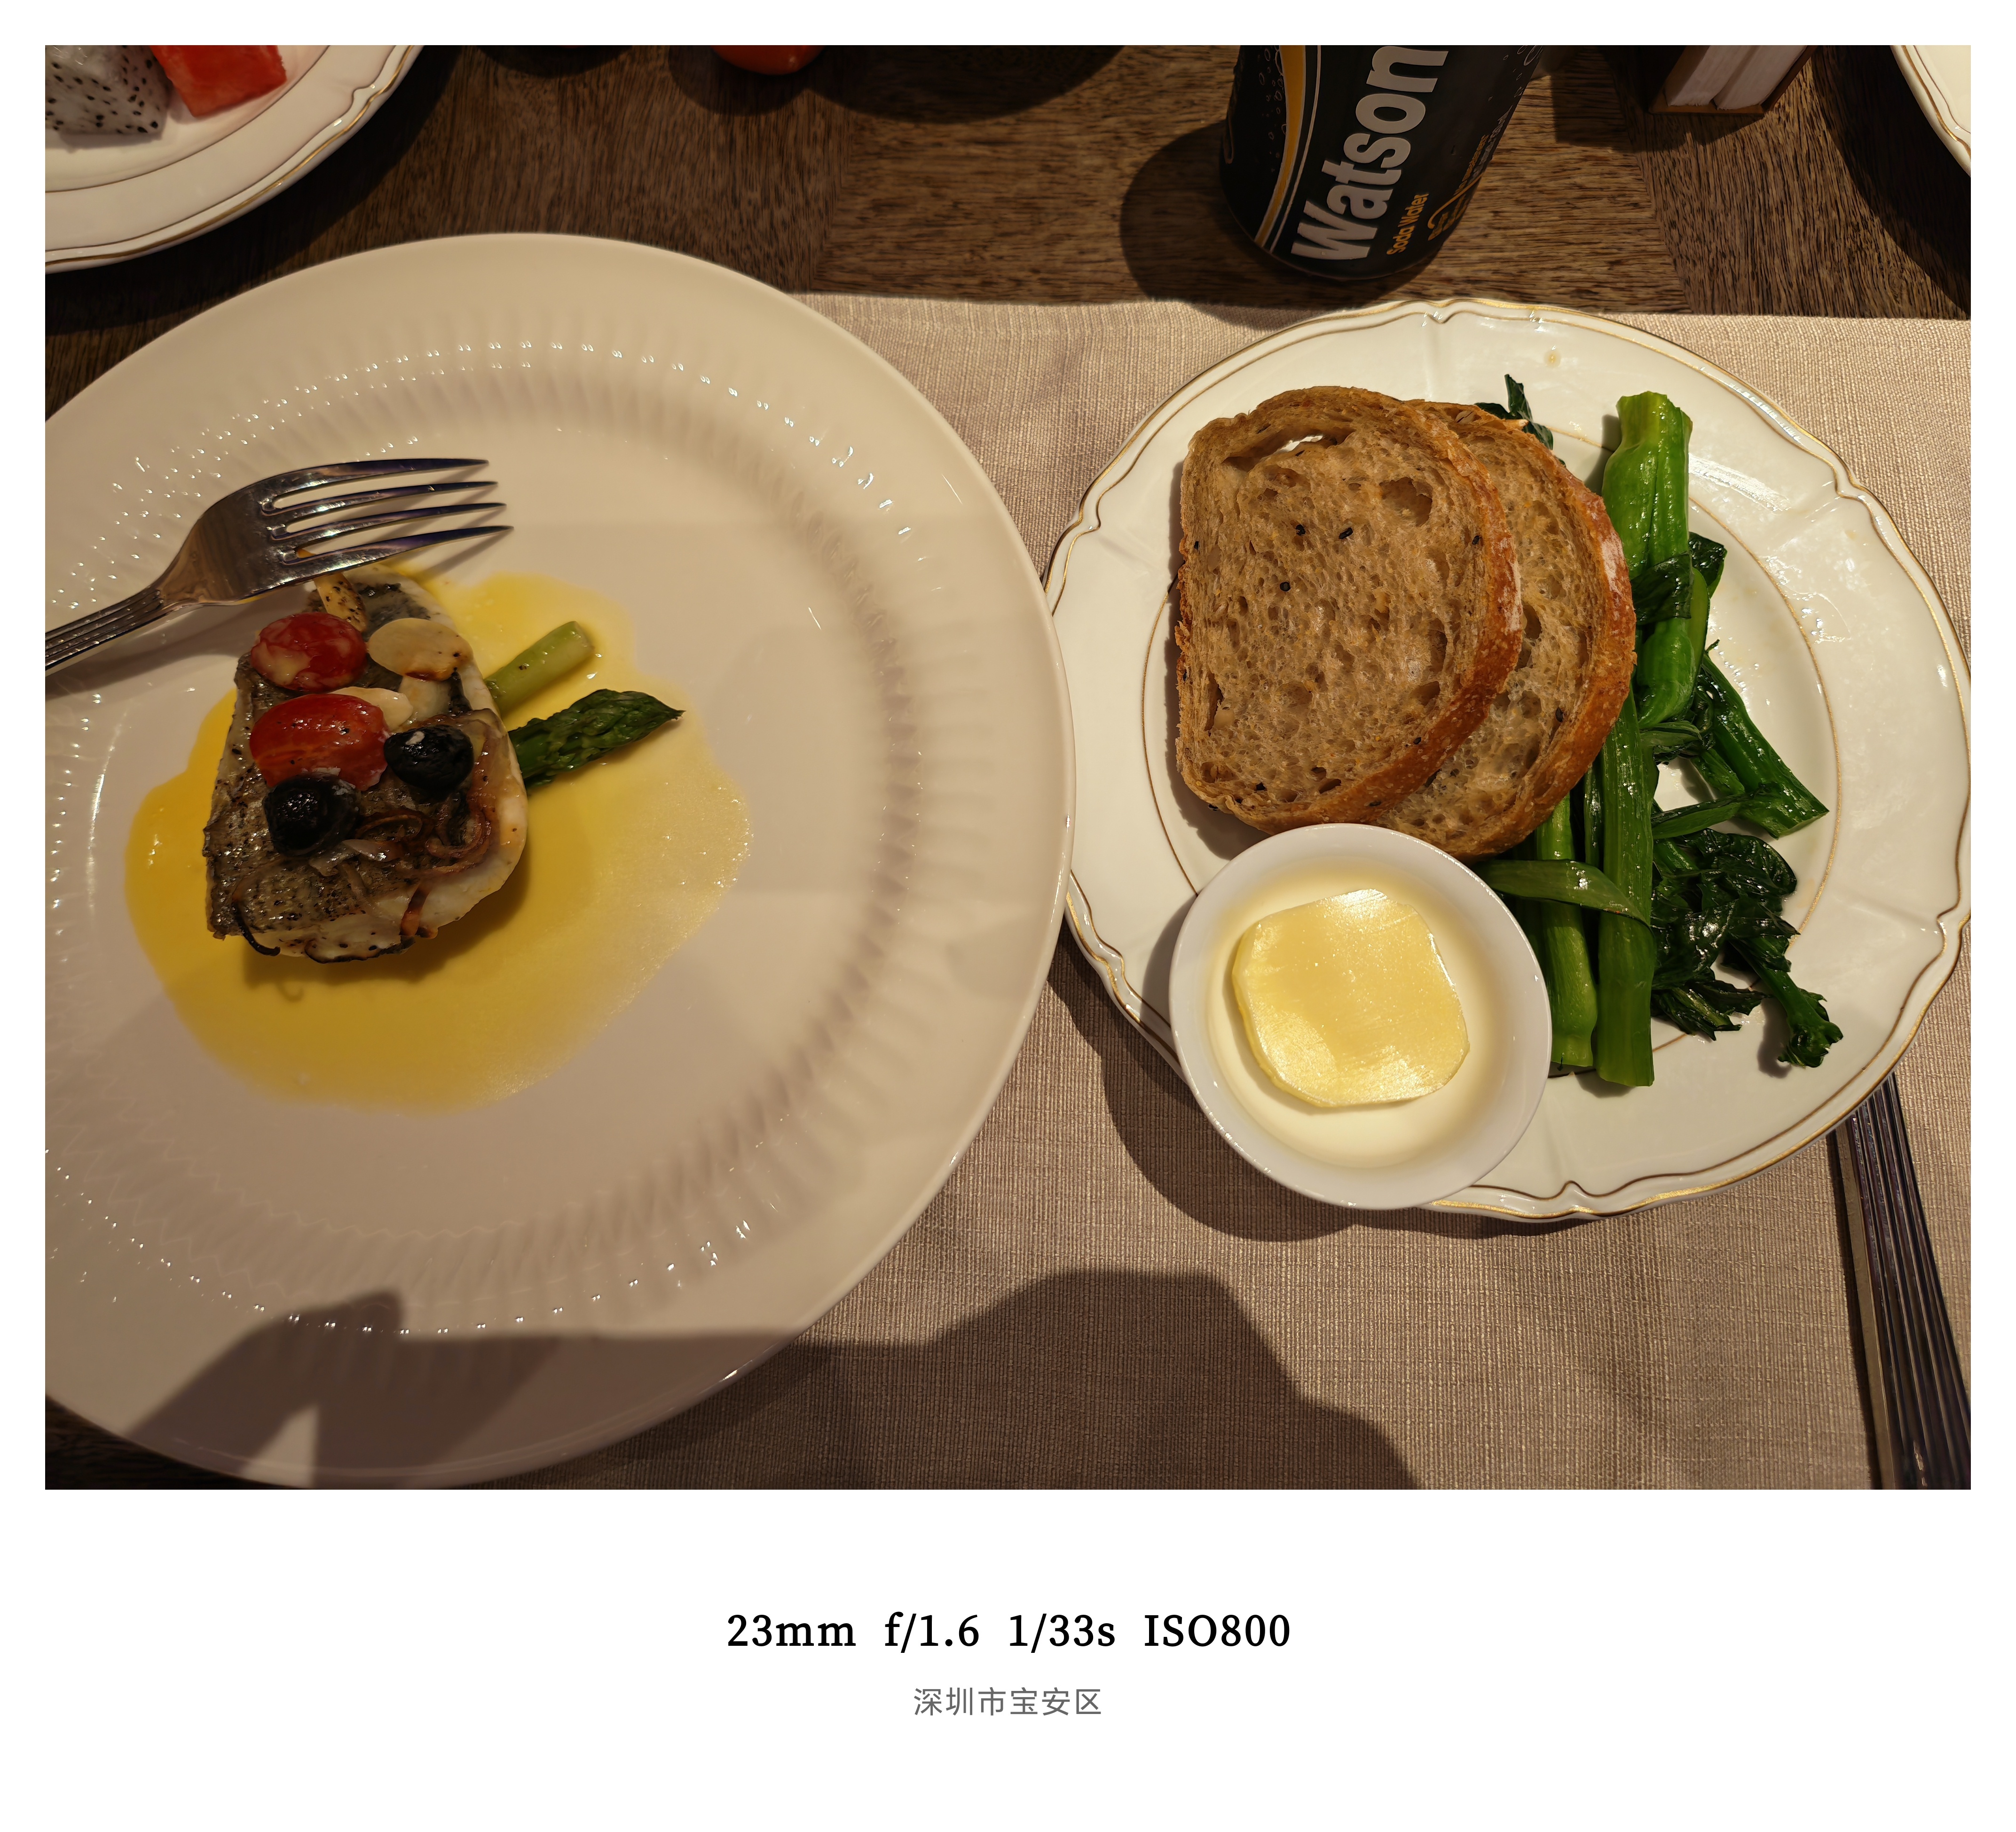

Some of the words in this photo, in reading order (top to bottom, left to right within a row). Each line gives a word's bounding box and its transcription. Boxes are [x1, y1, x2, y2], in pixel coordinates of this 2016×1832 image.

[1291, 46, 1449, 260] Watson
[1397, 193, 1430, 227] Water
[1386, 225, 1415, 255] Soda
